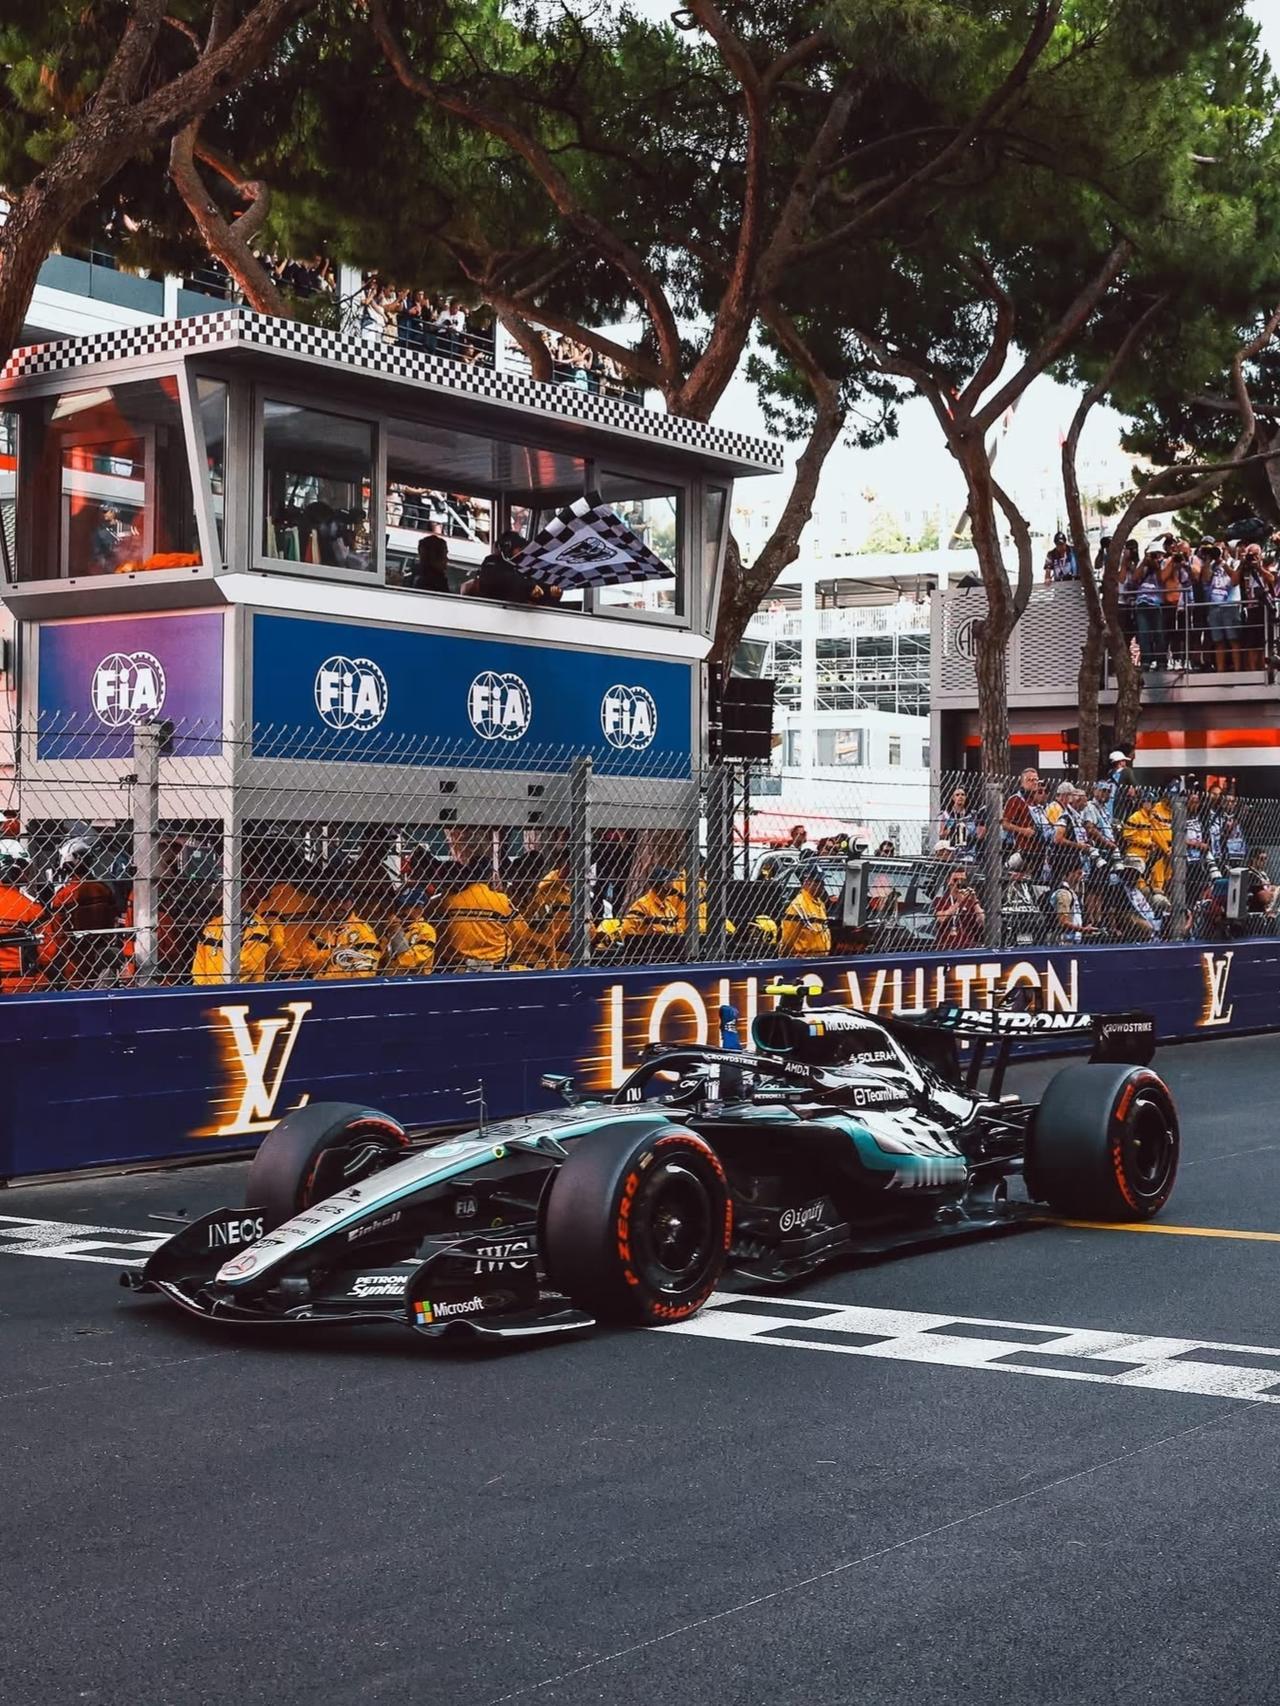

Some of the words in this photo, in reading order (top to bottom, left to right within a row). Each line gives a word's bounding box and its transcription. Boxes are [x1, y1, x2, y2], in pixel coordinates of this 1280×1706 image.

[1104, 1022, 1153, 1033] CROWDSTRIKE
[706, 1053, 759, 1067] CROWDSTRIKE
[858, 1051, 892, 1064] SOLERA
[784, 1062, 803, 1075] AMD
[207, 1217, 264, 1248] INEOS
[473, 1242, 530, 1275] IWC
[432, 1296, 485, 1318] Microsoft
